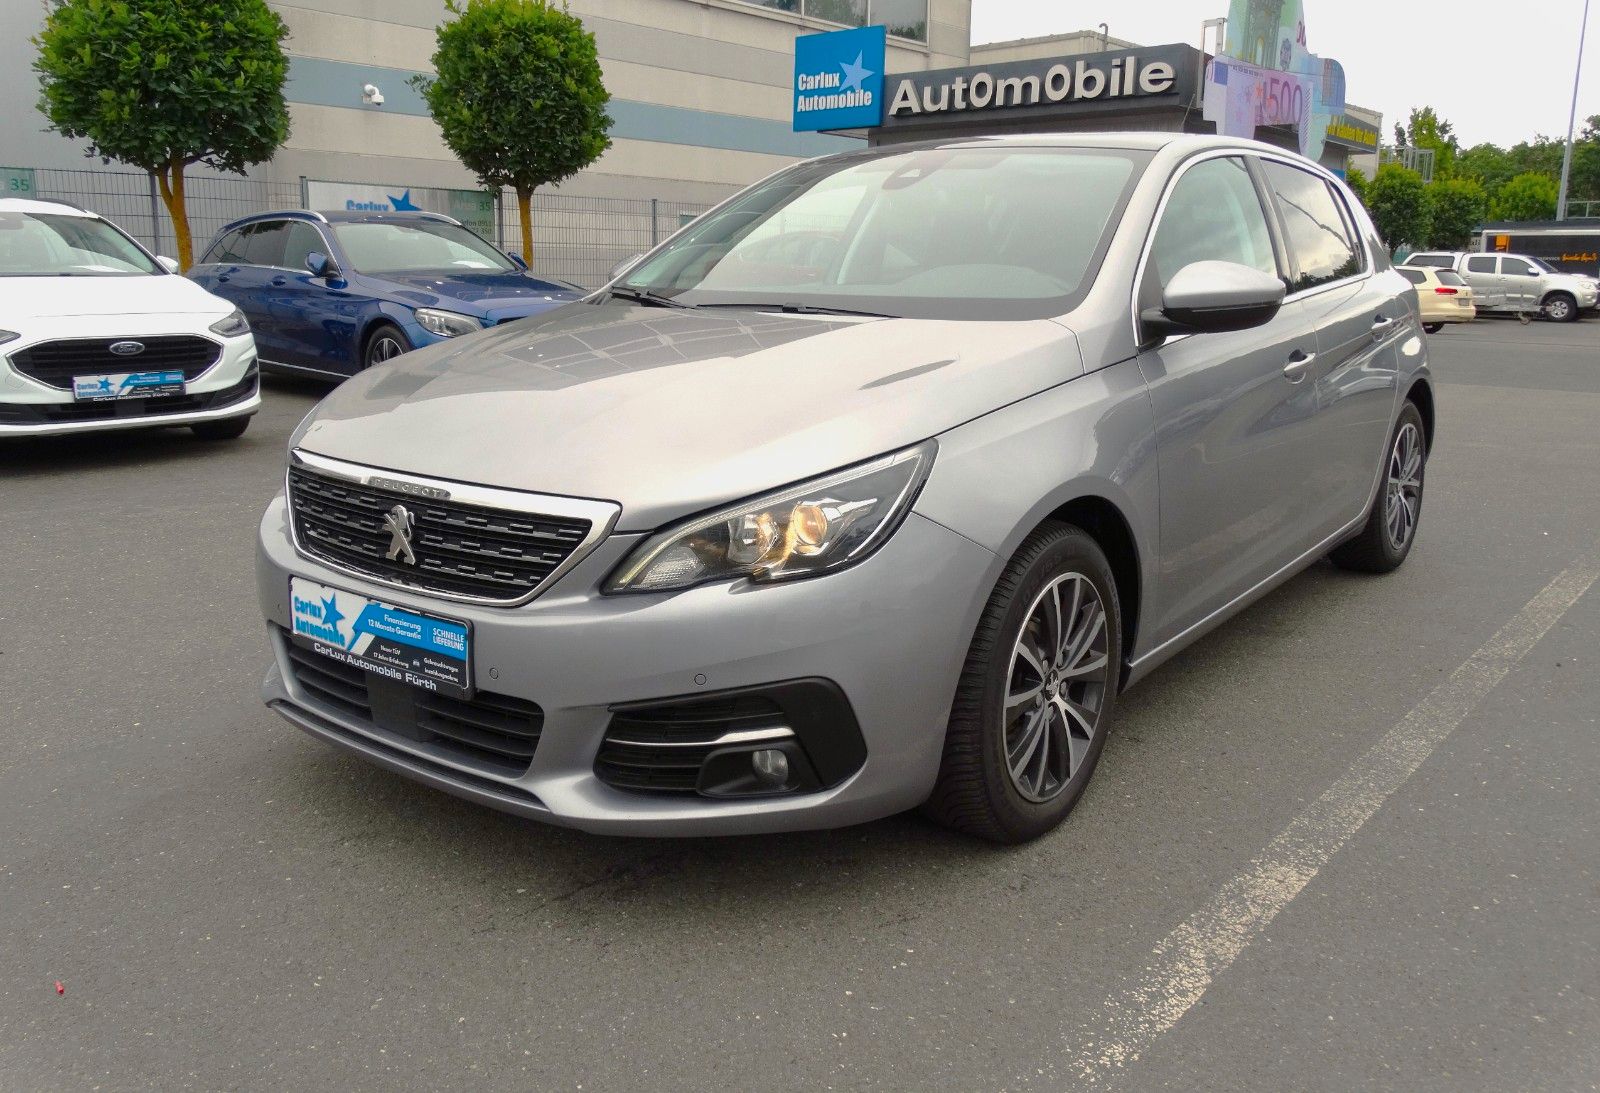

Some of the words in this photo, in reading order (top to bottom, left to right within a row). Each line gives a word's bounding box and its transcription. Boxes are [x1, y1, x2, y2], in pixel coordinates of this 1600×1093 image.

[798, 72, 840, 91] Carlux
[797, 89, 872, 112] Automobile
[10, 178, 30, 192] 35
[374, 478, 439, 497] PEUGEOT
[294, 595, 322, 619] Carlux
[432, 627, 465, 643] SCHNELLE
[432, 636, 465, 651] LIEFERUNG
[314, 642, 346, 662] CarLux
[346, 654, 402, 681] Automobile
[405, 672, 437, 691] Fürth
